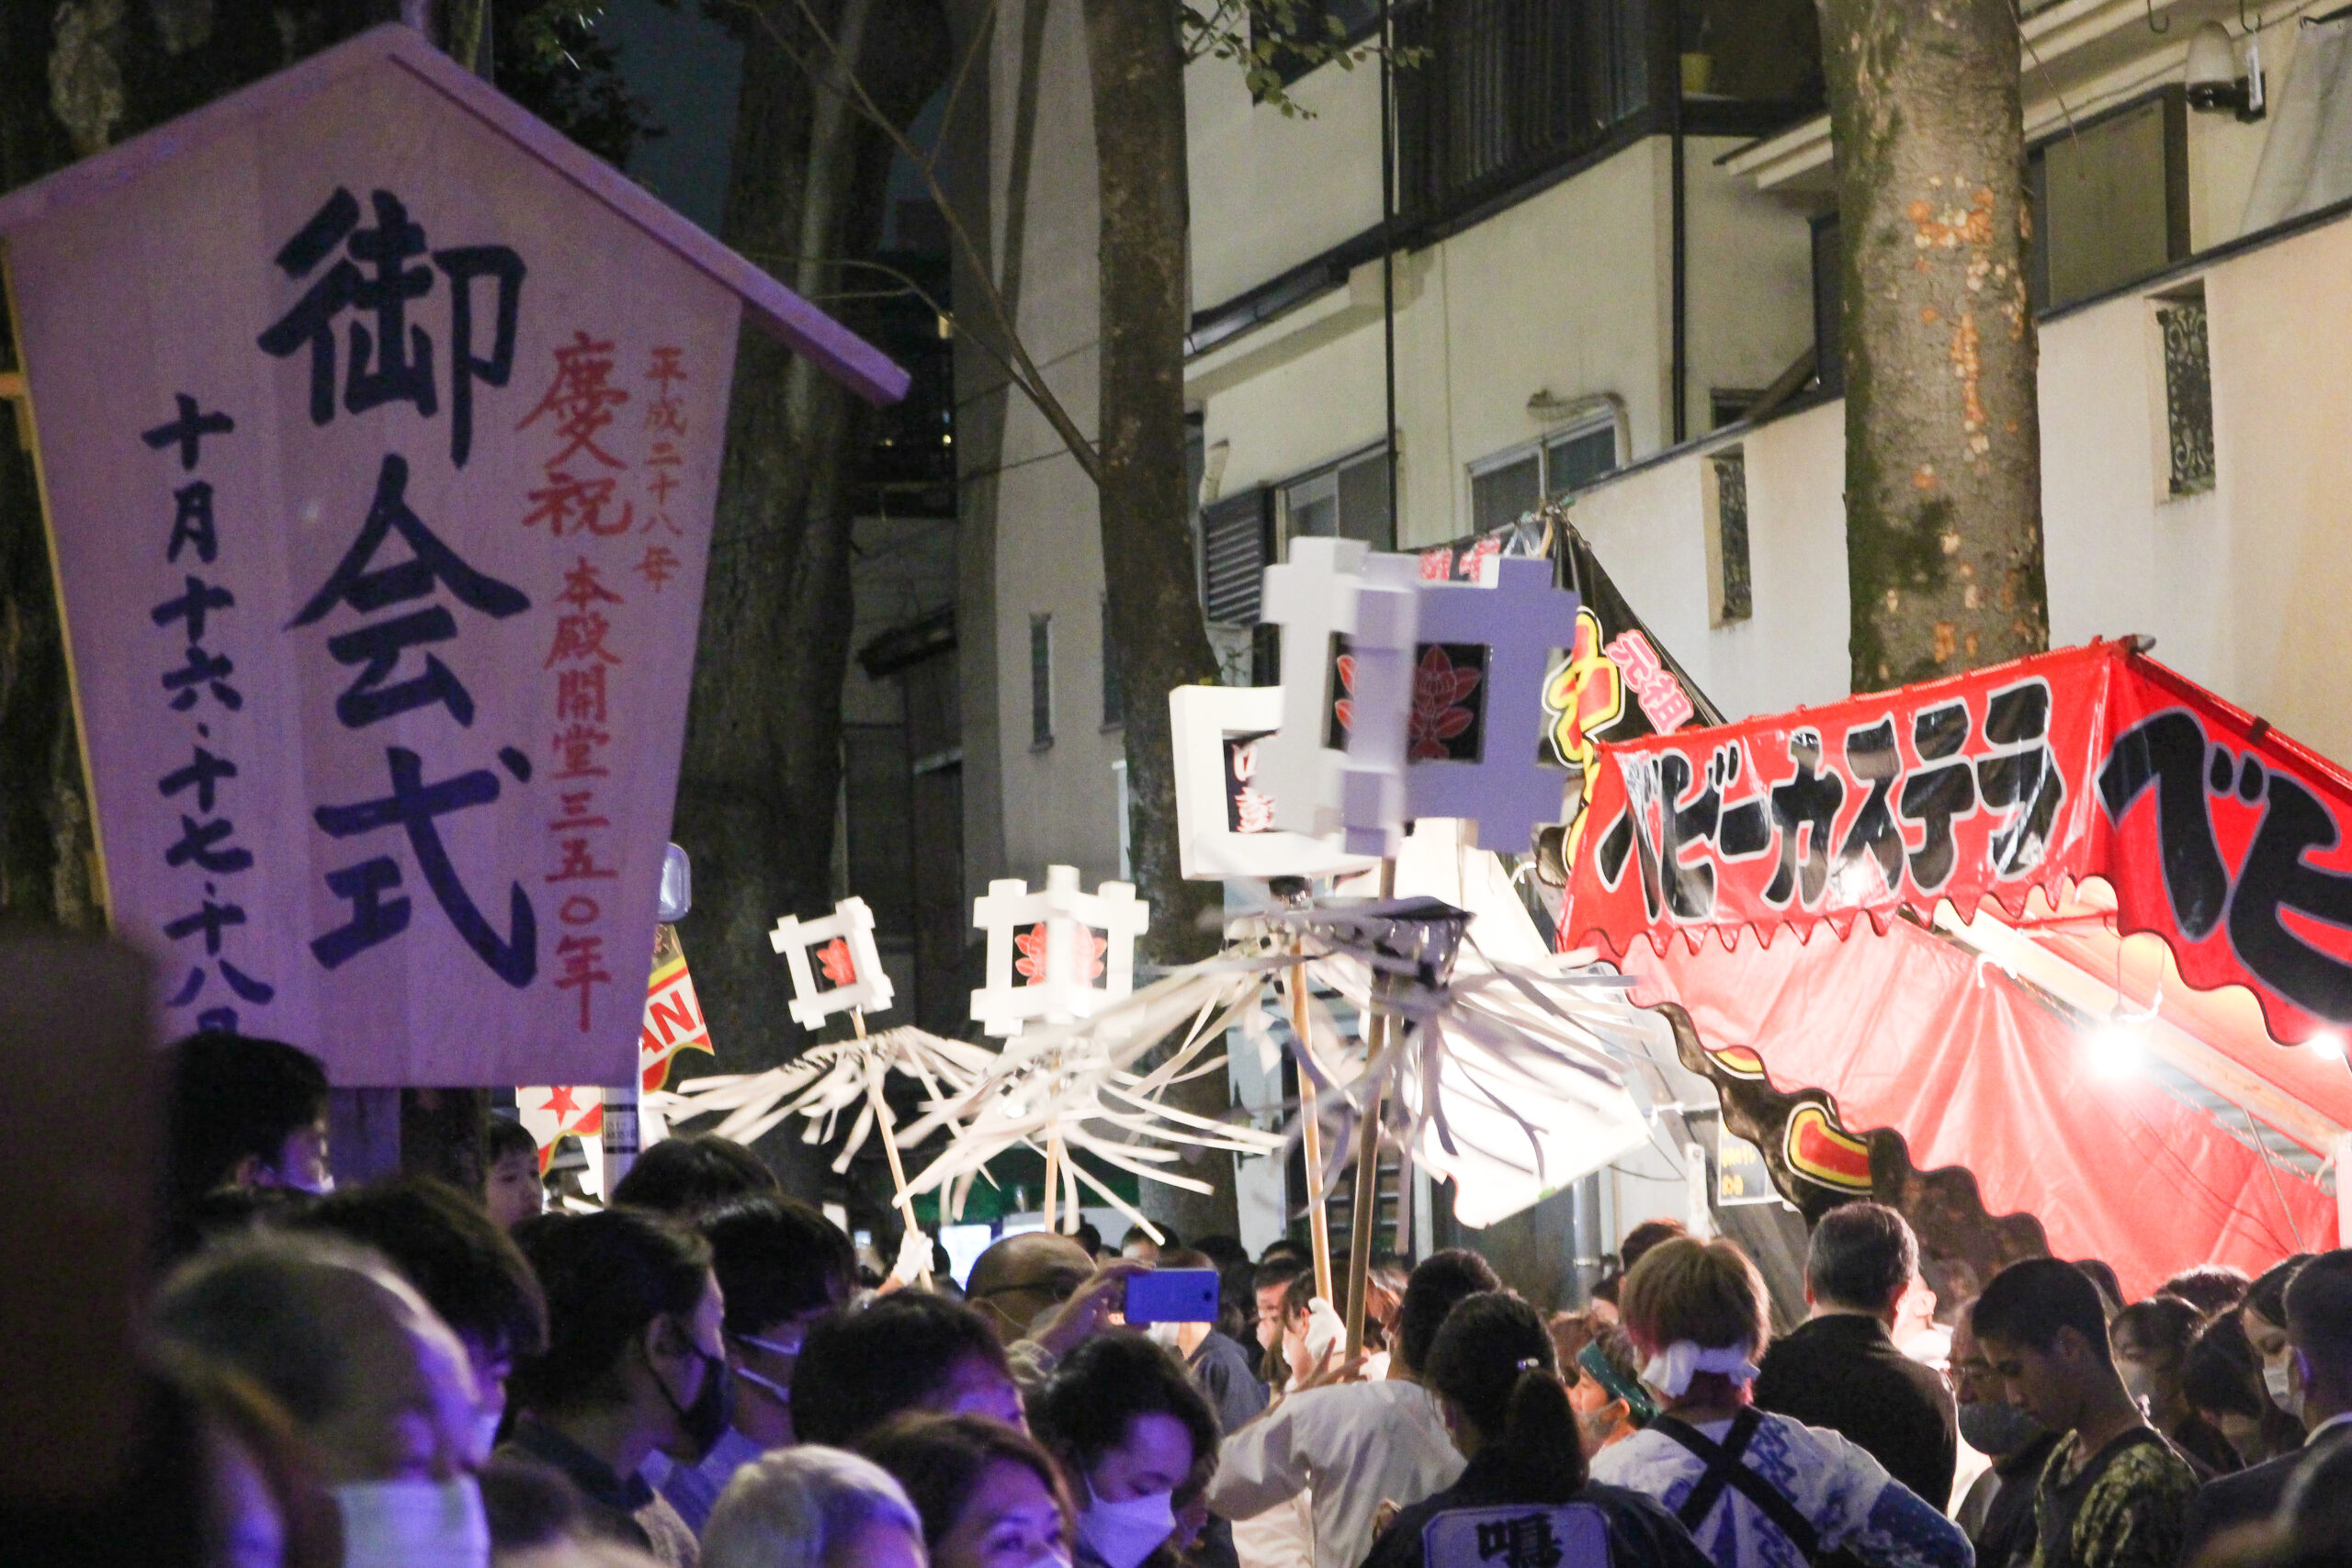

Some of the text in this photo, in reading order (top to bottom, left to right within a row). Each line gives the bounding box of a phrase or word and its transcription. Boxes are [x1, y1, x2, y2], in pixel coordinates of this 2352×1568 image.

[258, 188, 538, 988] 御会式
[1606, 629, 1694, 735] 元祖
[1595, 676, 2064, 924] ベビーカステラ
